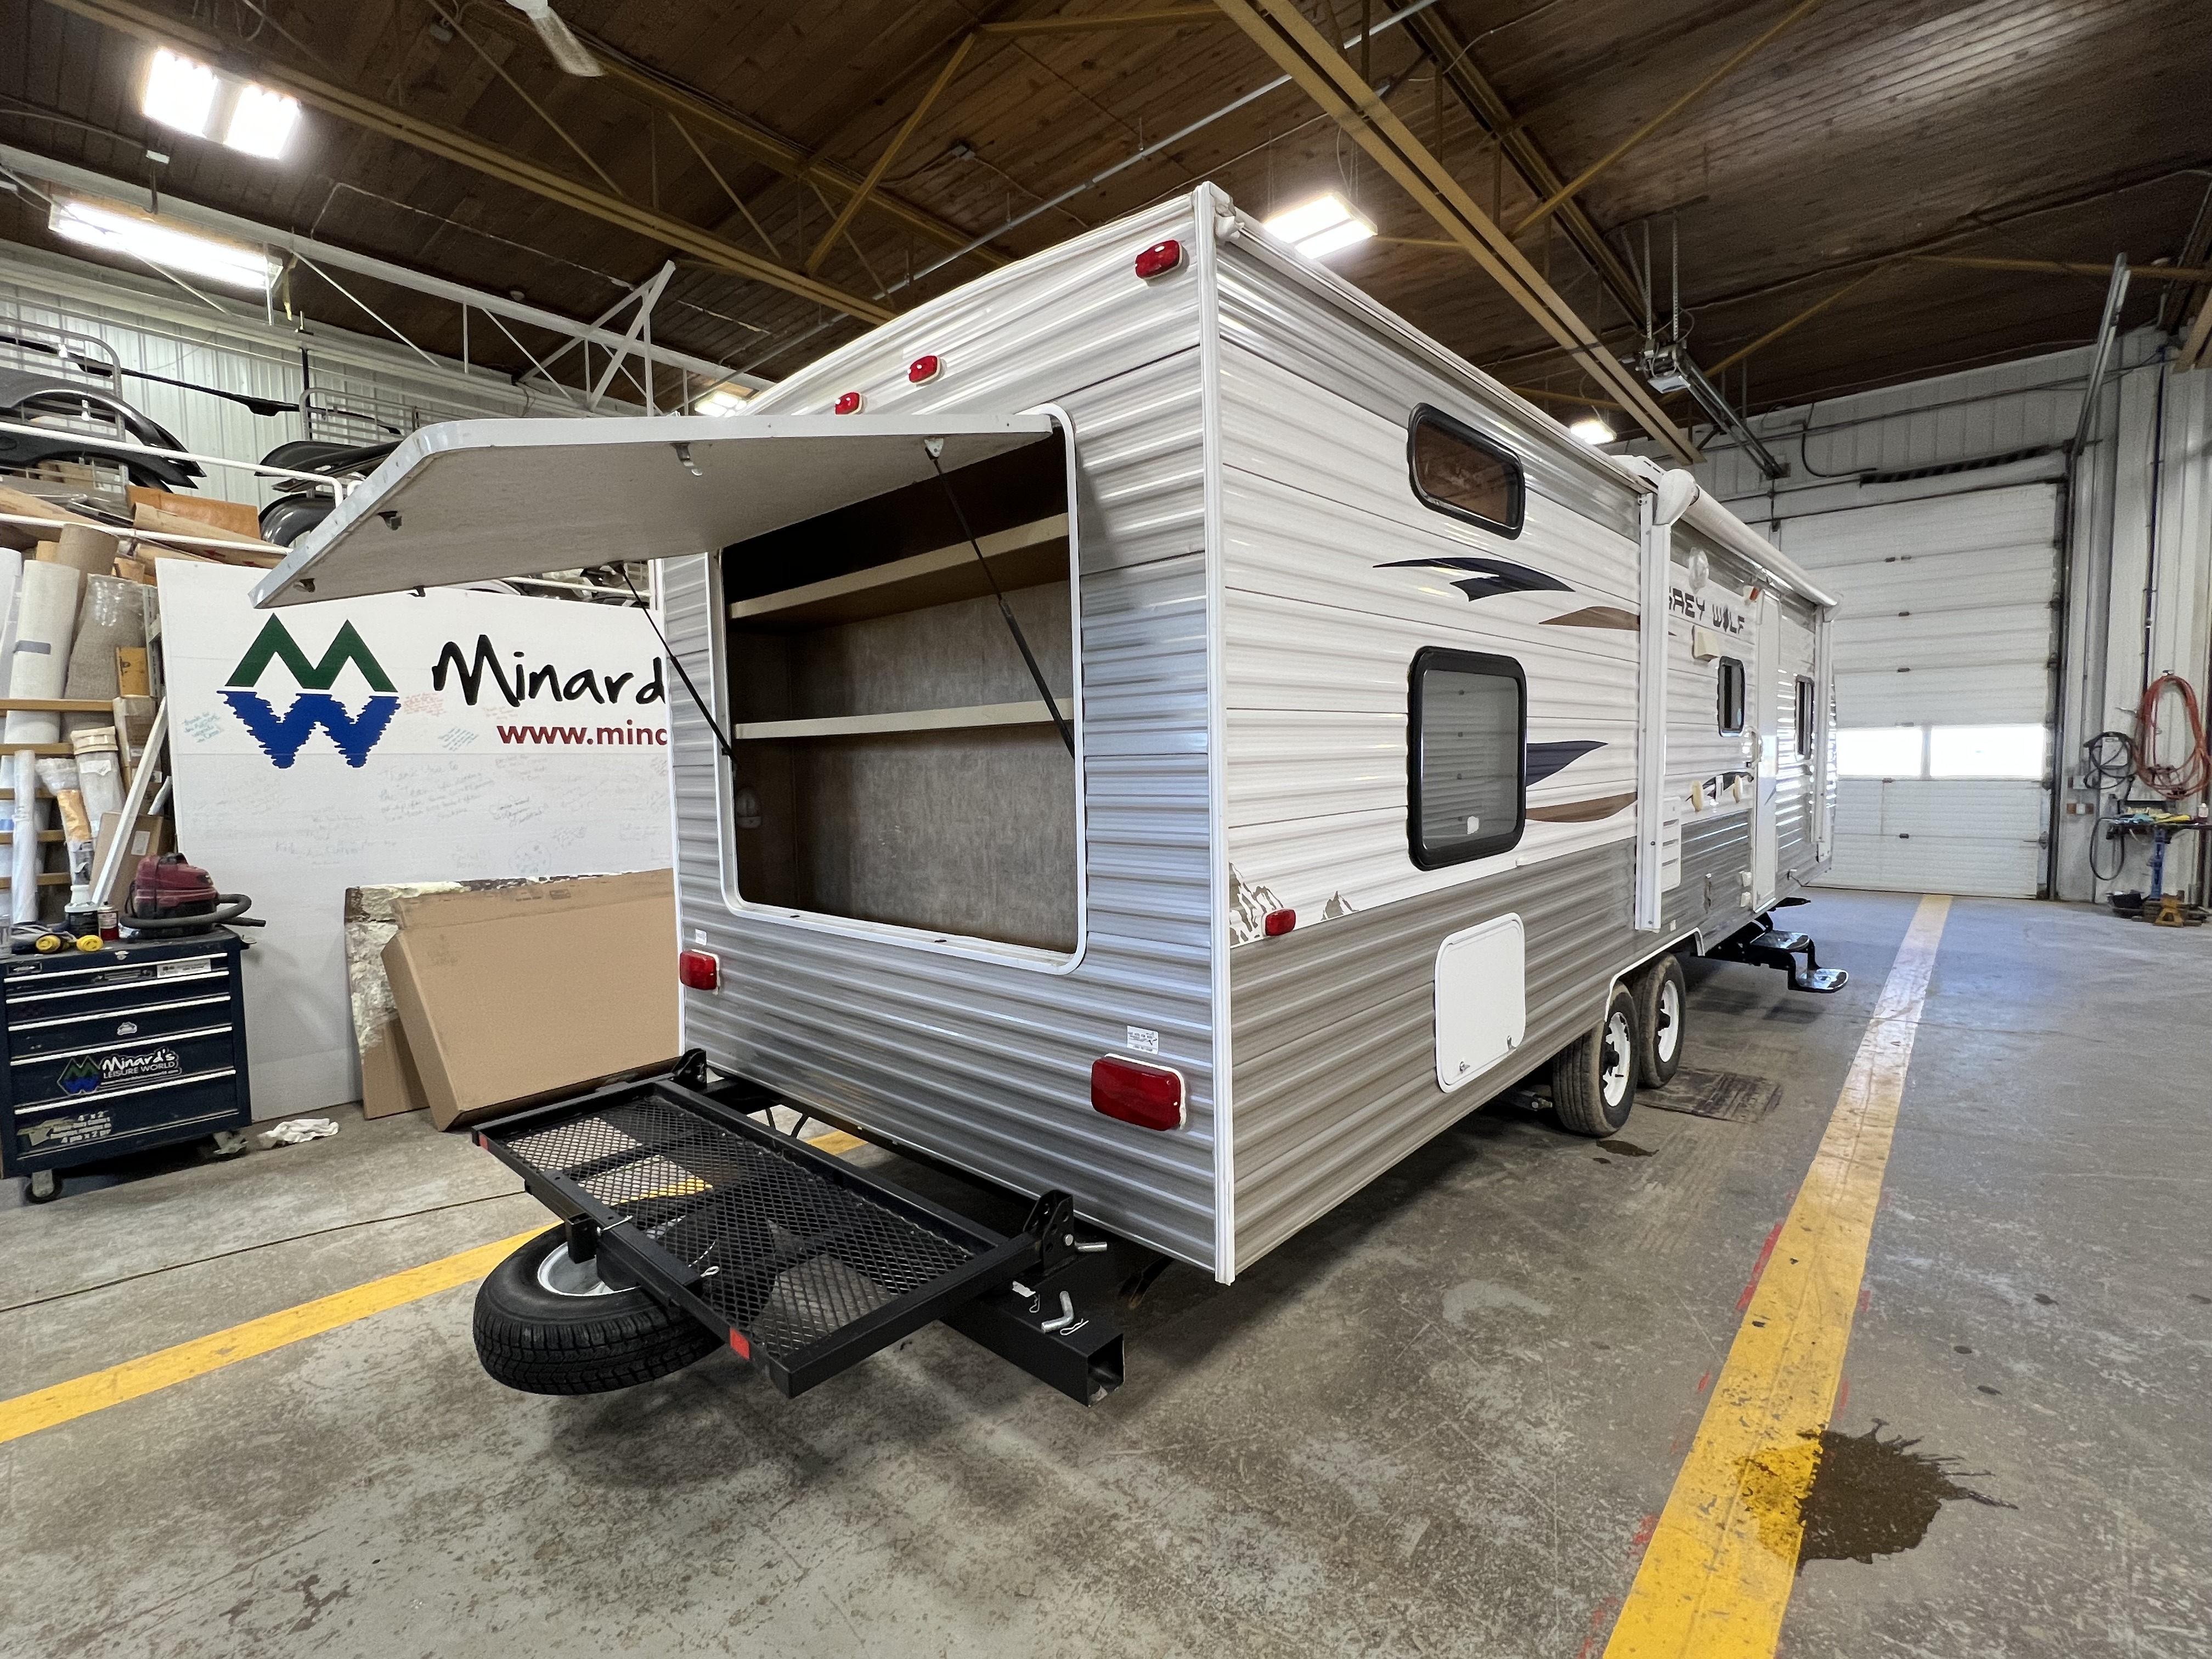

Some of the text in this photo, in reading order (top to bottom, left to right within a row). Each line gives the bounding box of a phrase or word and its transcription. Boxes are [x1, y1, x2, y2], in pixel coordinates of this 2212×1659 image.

[432, 634, 665, 707] Minard
[102, 1048, 175, 1071] Minard's
[103, 1068, 139, 1079] LEISURE
[140, 1062, 175, 1072] WORLD
